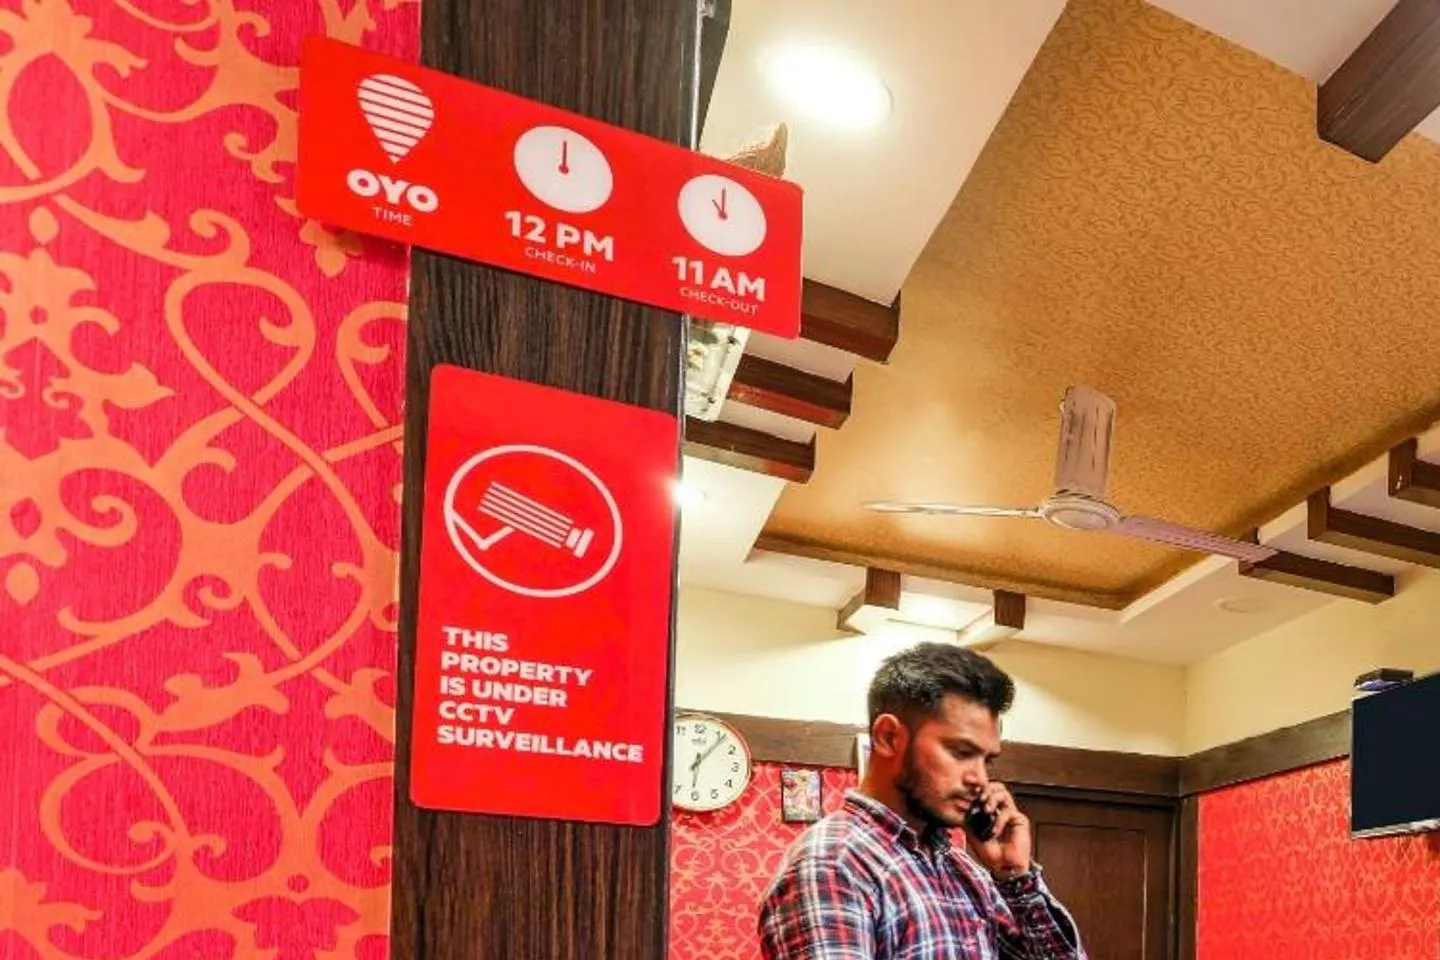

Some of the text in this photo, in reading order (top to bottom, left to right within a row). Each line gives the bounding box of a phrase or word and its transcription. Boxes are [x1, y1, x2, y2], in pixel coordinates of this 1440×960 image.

[346, 168, 439, 213] OYO
[371, 204, 413, 229] TIME
[504, 210, 614, 262] 12 PM
[525, 246, 597, 274] CHECK-IN
[672, 256, 766, 302] 11 AM
[679, 287, 759, 316] CHECK-OUT
[442, 626, 509, 652] THIS
[441, 651, 593, 686] PROPERTY
[440, 675, 568, 708] IS UNDER
[438, 700, 515, 725] CCTV
[437, 725, 644, 763] SURVEILLANCE
[728, 744, 736, 756] 2
[731, 762, 739, 773] 3
[691, 791, 699, 801] 6
[711, 789, 719, 800] 5
[724, 779, 733, 788] 4
